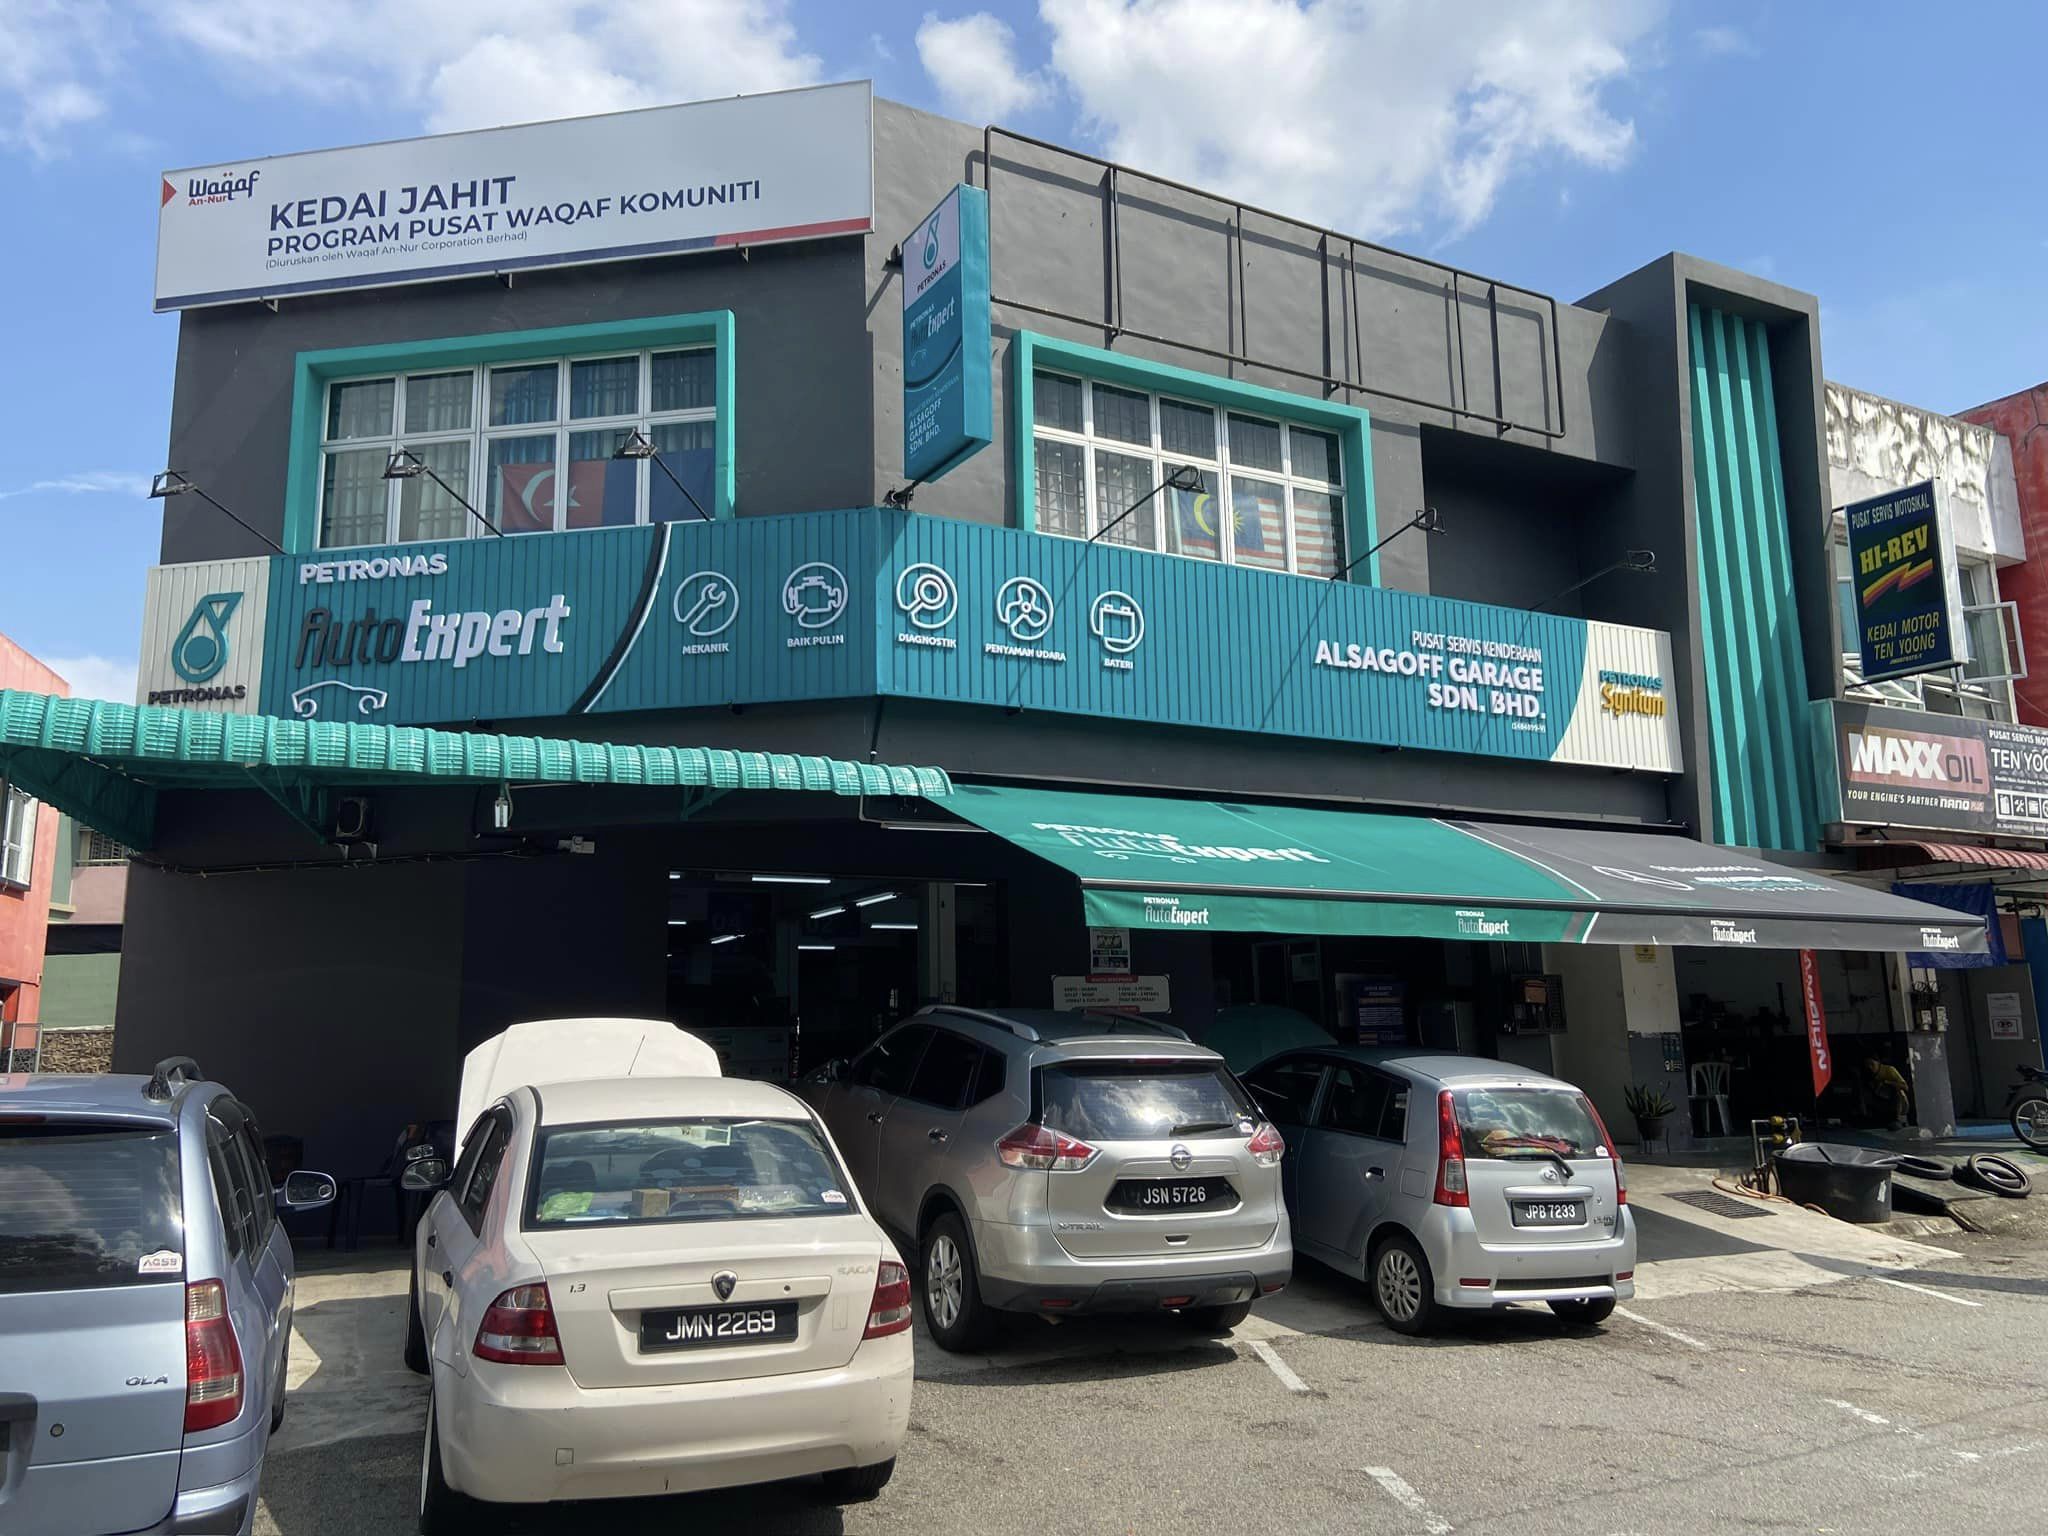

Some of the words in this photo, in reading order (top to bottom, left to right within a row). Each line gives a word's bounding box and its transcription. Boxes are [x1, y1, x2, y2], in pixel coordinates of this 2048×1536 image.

[188, 195, 227, 206] An-Nur
[270, 190, 387, 231] KEDAI
[398, 176, 516, 214] JAHIT
[267, 222, 399, 256] PROGRAM
[409, 212, 498, 239] PUSAT
[506, 197, 611, 228] WAQAF
[620, 180, 760, 215] KOMUNITI
[265, 256, 320, 270] (Diuruskan
[322, 252, 343, 262] oleh
[346, 247, 379, 259] Waqaf
[382, 243, 418, 254] An-Nur
[421, 236, 483, 251] Corporation
[486, 231, 527, 244] Berhad)
[917, 260, 946, 293] PETRONAS
[909, 398, 941, 430] ALSAGOFF
[909, 415, 935, 441] GARAGE
[1852, 510, 1870, 529] PUSAT
[1872, 503, 1893, 524] SERVIS
[1895, 492, 1930, 517] MOTOSIKAL
[1859, 523, 1929, 575] HI-REV
[300, 553, 447, 585] PETRONAS
[787, 636, 810, 647] BAIK
[898, 633, 957, 648] DIAGNOSTIK
[1867, 622, 1896, 643] KEDAI
[1902, 611, 1939, 635] MOTOR
[682, 643, 729, 655] MEKANIK
[985, 643, 1034, 657] PENYAMAN
[1036, 650, 1066, 661] UDARA
[1412, 630, 1445, 650] PUSAT
[1446, 635, 1482, 655] SERVIS
[1483, 640, 1542, 663] KENDERAAN
[1874, 641, 1894, 661] TEN
[1899, 632, 1935, 655] YOONG
[1104, 658, 1133, 669] BATERI
[1314, 639, 1443, 679] ALSAGOFF
[1448, 659, 1544, 692] GARAGE
[1600, 670, 1663, 690] PETRONAS
[148, 685, 247, 706] PETRONAS
[1427, 683, 1486, 713] SDN.
[1491, 690, 1546, 719] BHD.
[1601, 684, 1666, 719] Syntium
[1989, 729, 2010, 739] PUSAT
[2011, 732, 2034, 744] SERVIS
[1848, 733, 1948, 780] MAXX
[1945, 754, 1983, 784] OIL
[1991, 747, 2020, 770] TEN
[1848, 790, 1867, 799] YOUR
[1871, 792, 1904, 803] ENGINE'S
[1907, 795, 1938, 807] PARTNER
[1144, 1187, 1170, 1204] JSN
[1173, 1186, 1206, 1203] 5726
[1525, 1205, 1546, 1219] JPB
[1549, 1204, 1576, 1219] 7233
[570, 1283, 586, 1294] 1.3
[666, 1313, 714, 1342] JMN
[717, 1309, 777, 1333] 2269
